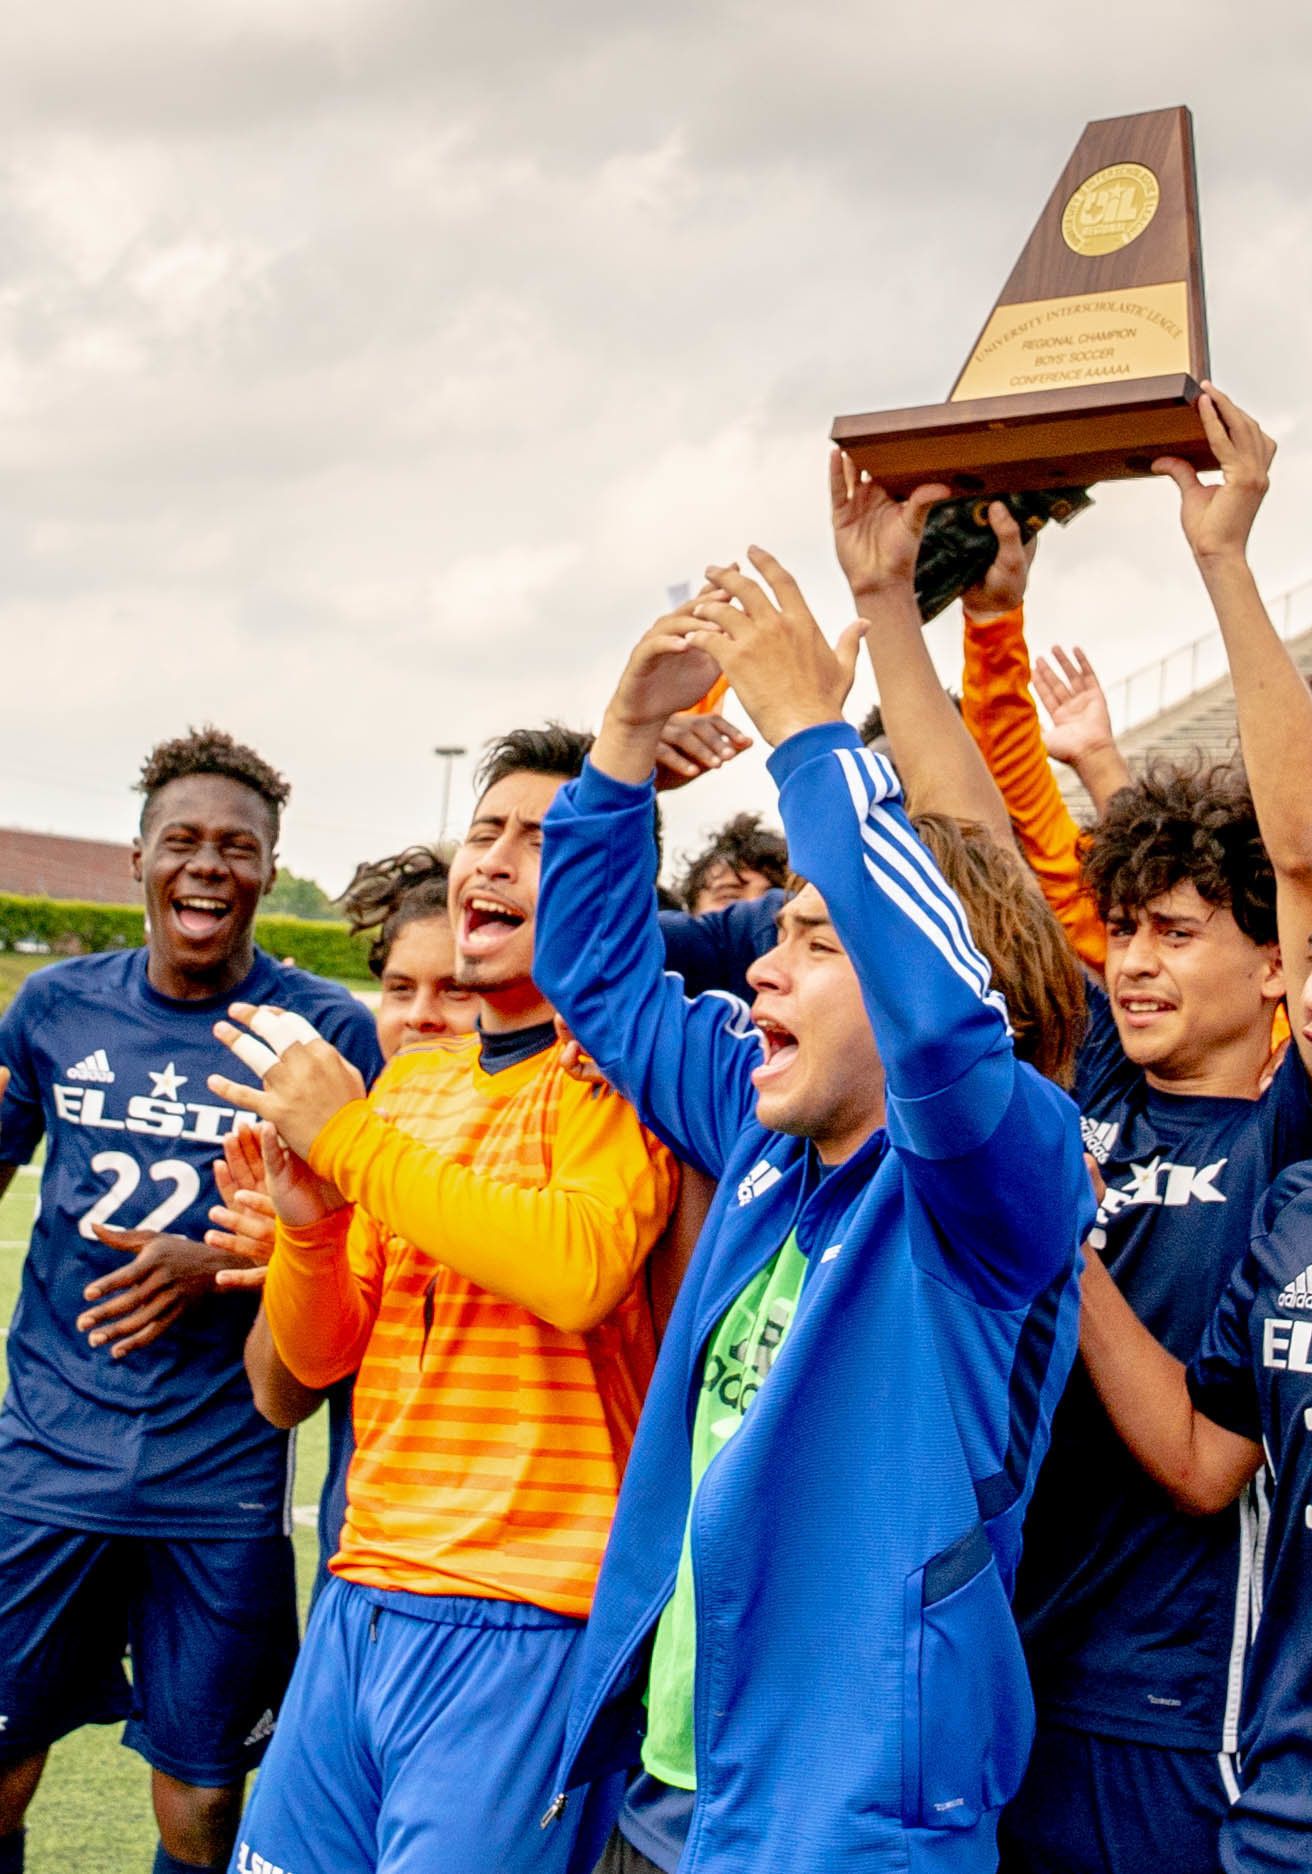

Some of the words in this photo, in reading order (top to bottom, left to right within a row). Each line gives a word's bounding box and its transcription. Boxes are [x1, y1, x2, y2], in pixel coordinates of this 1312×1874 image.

[975, 316, 1043, 363] UNIVERSITY
[1046, 301, 1148, 322] INTERSCHOLASTIC
[1149, 310, 1184, 340] LEAGUE
[1021, 335, 1073, 351] REGIONAL
[1078, 327, 1137, 345] CHAMPION
[1069, 348, 1115, 364] SOCCER
[1009, 371, 1082, 387] CONFERENCE
[78, 1150, 201, 1240] 22
